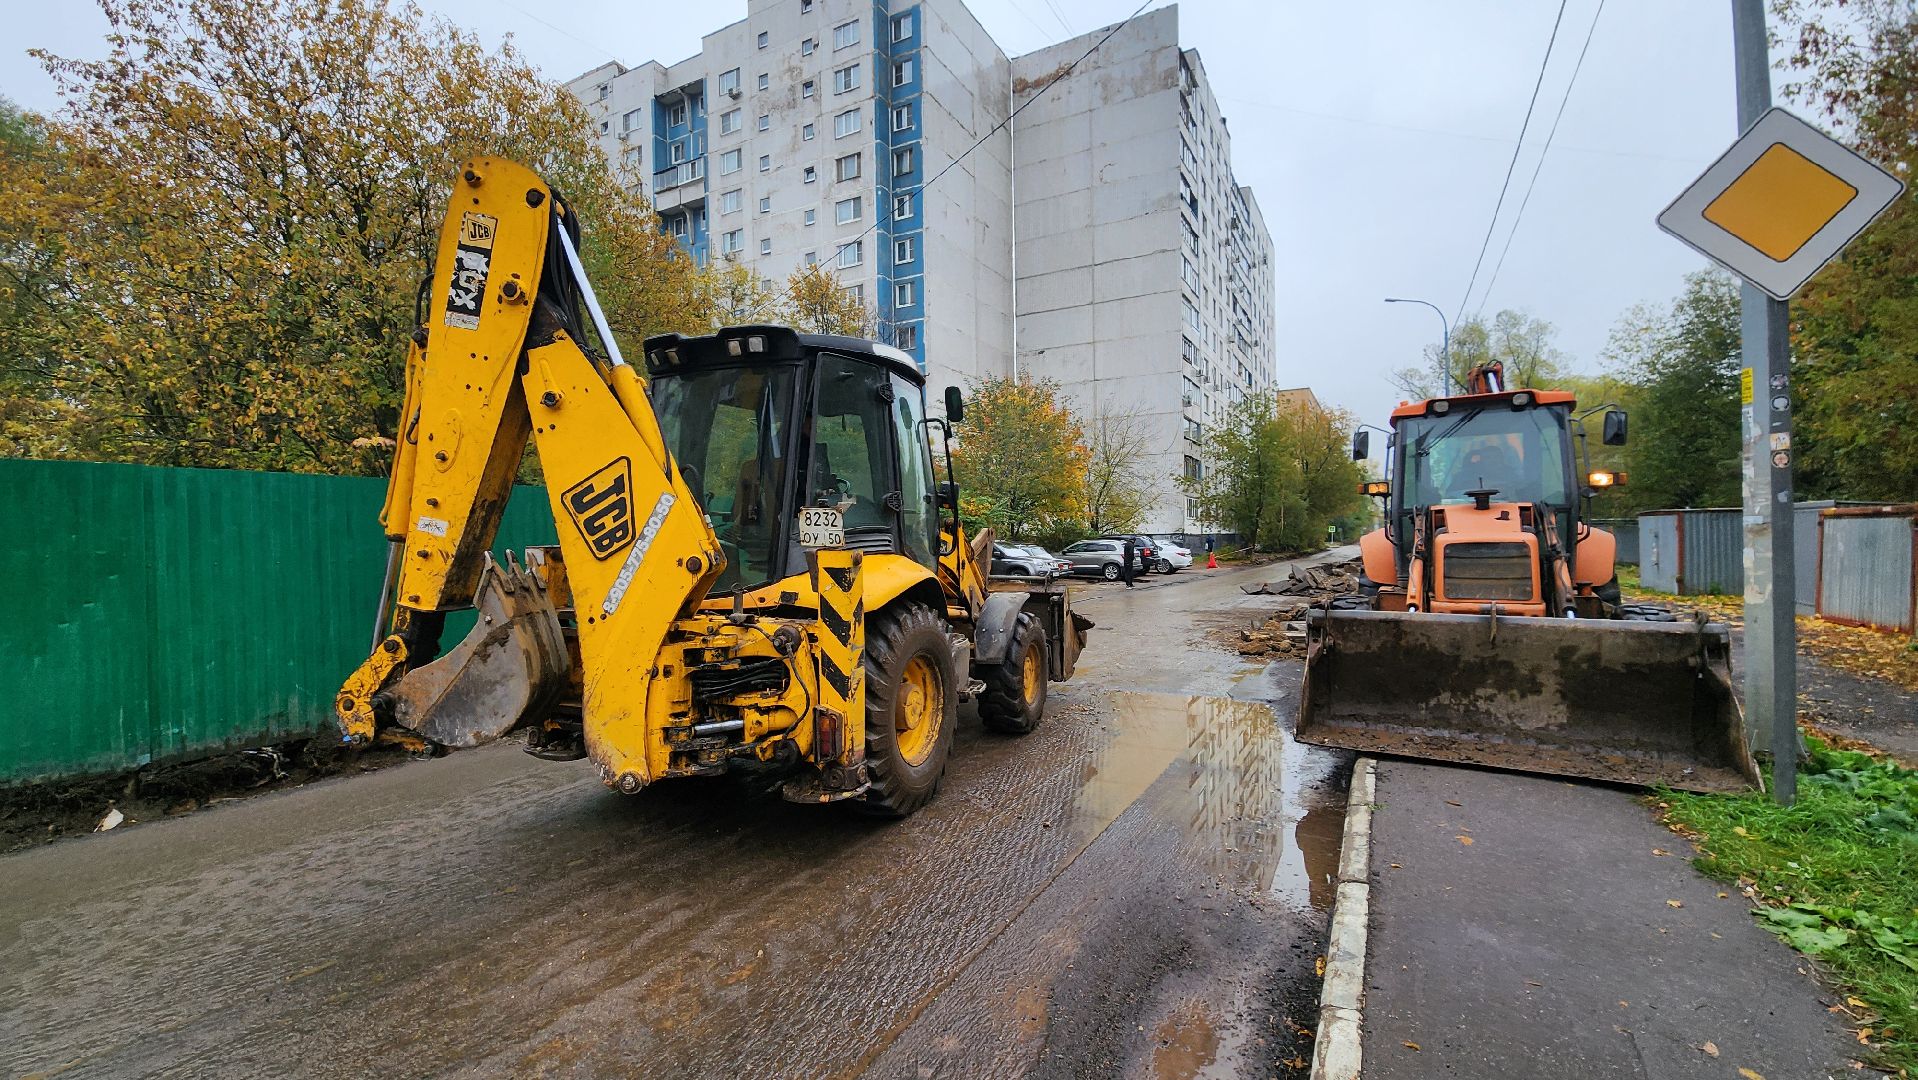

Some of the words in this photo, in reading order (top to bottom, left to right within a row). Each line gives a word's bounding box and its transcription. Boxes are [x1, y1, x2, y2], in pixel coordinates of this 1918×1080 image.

[470, 221, 490, 240] JCB
[570, 473, 629, 553] JCB
[804, 511, 838, 527] 8232
[828, 533, 841, 544] 50
